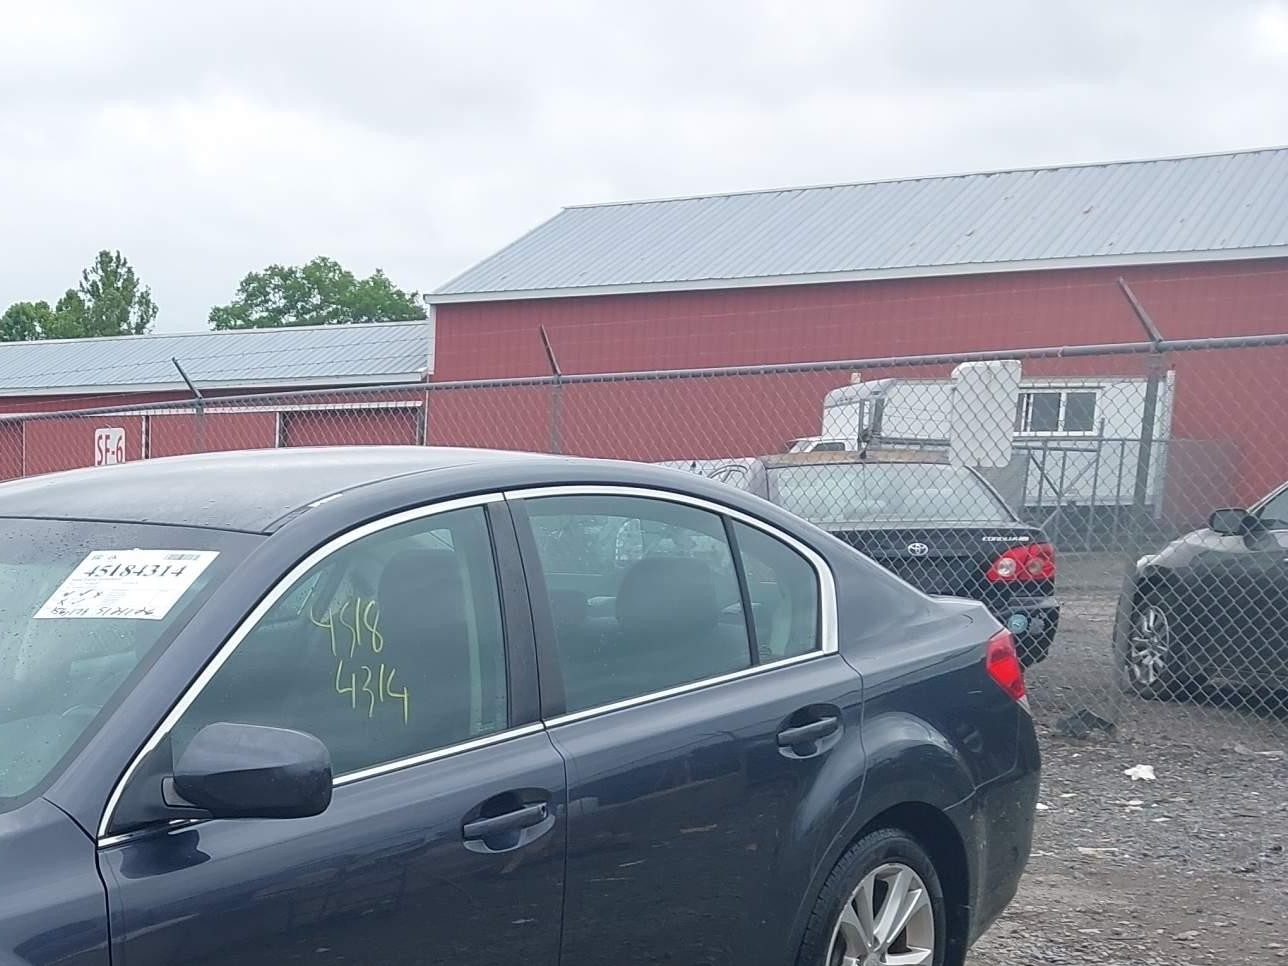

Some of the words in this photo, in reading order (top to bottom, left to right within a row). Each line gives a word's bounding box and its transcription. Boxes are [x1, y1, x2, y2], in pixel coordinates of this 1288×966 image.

[98, 434, 123, 465] SF-6
[84, 564, 187, 577] 45184314
[310, 597, 384, 658] 4518
[335, 660, 408, 725] 4314
